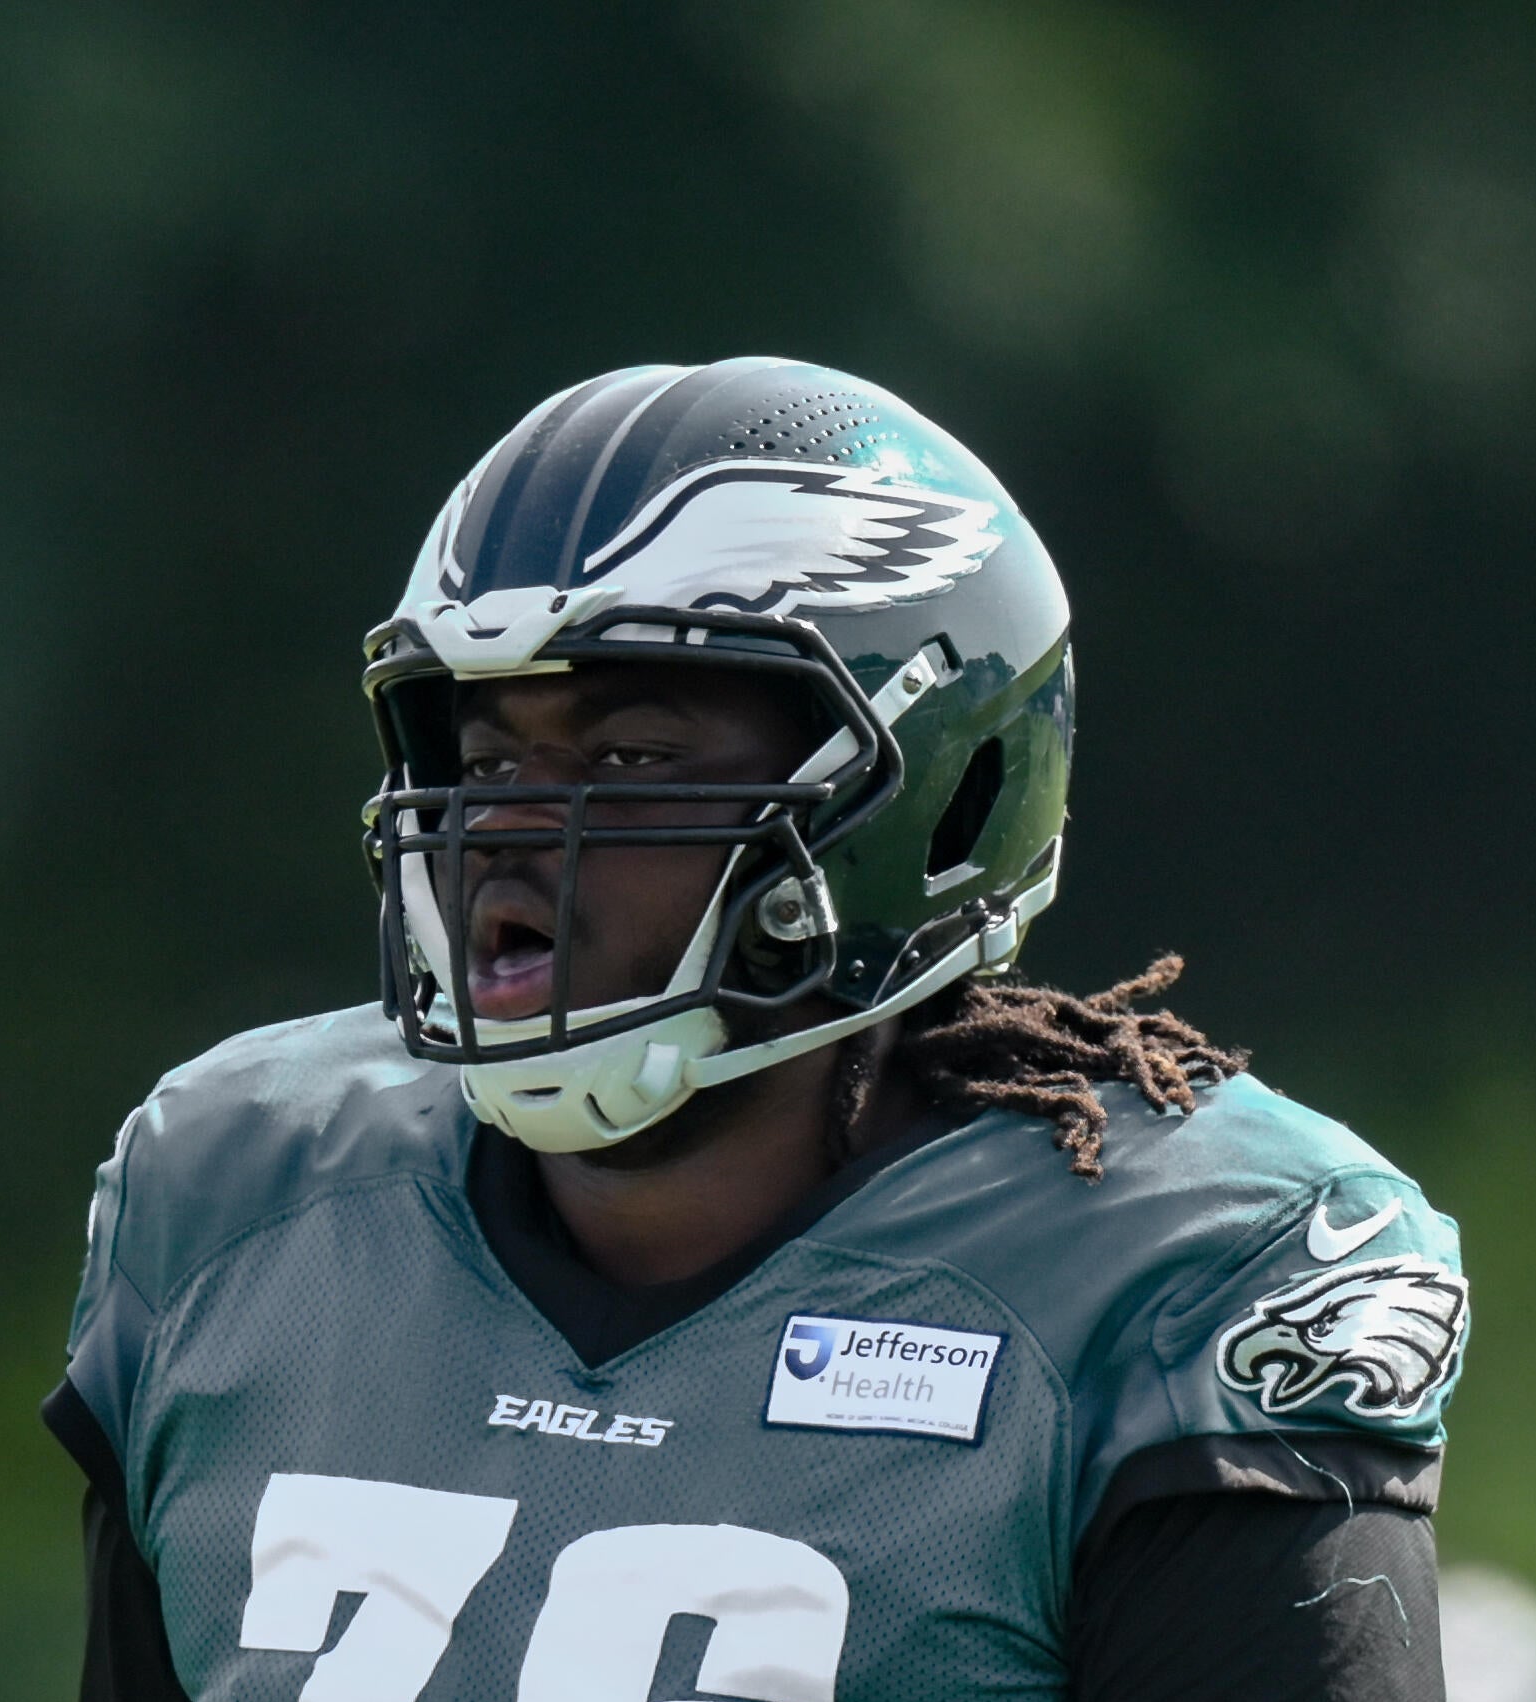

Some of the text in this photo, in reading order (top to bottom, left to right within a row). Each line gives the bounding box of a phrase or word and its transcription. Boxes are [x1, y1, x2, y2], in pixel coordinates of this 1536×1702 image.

[840, 1329, 988, 1369] Jefferson
[830, 1370, 934, 1403] Health
[488, 1394, 675, 1447] EAGLES
